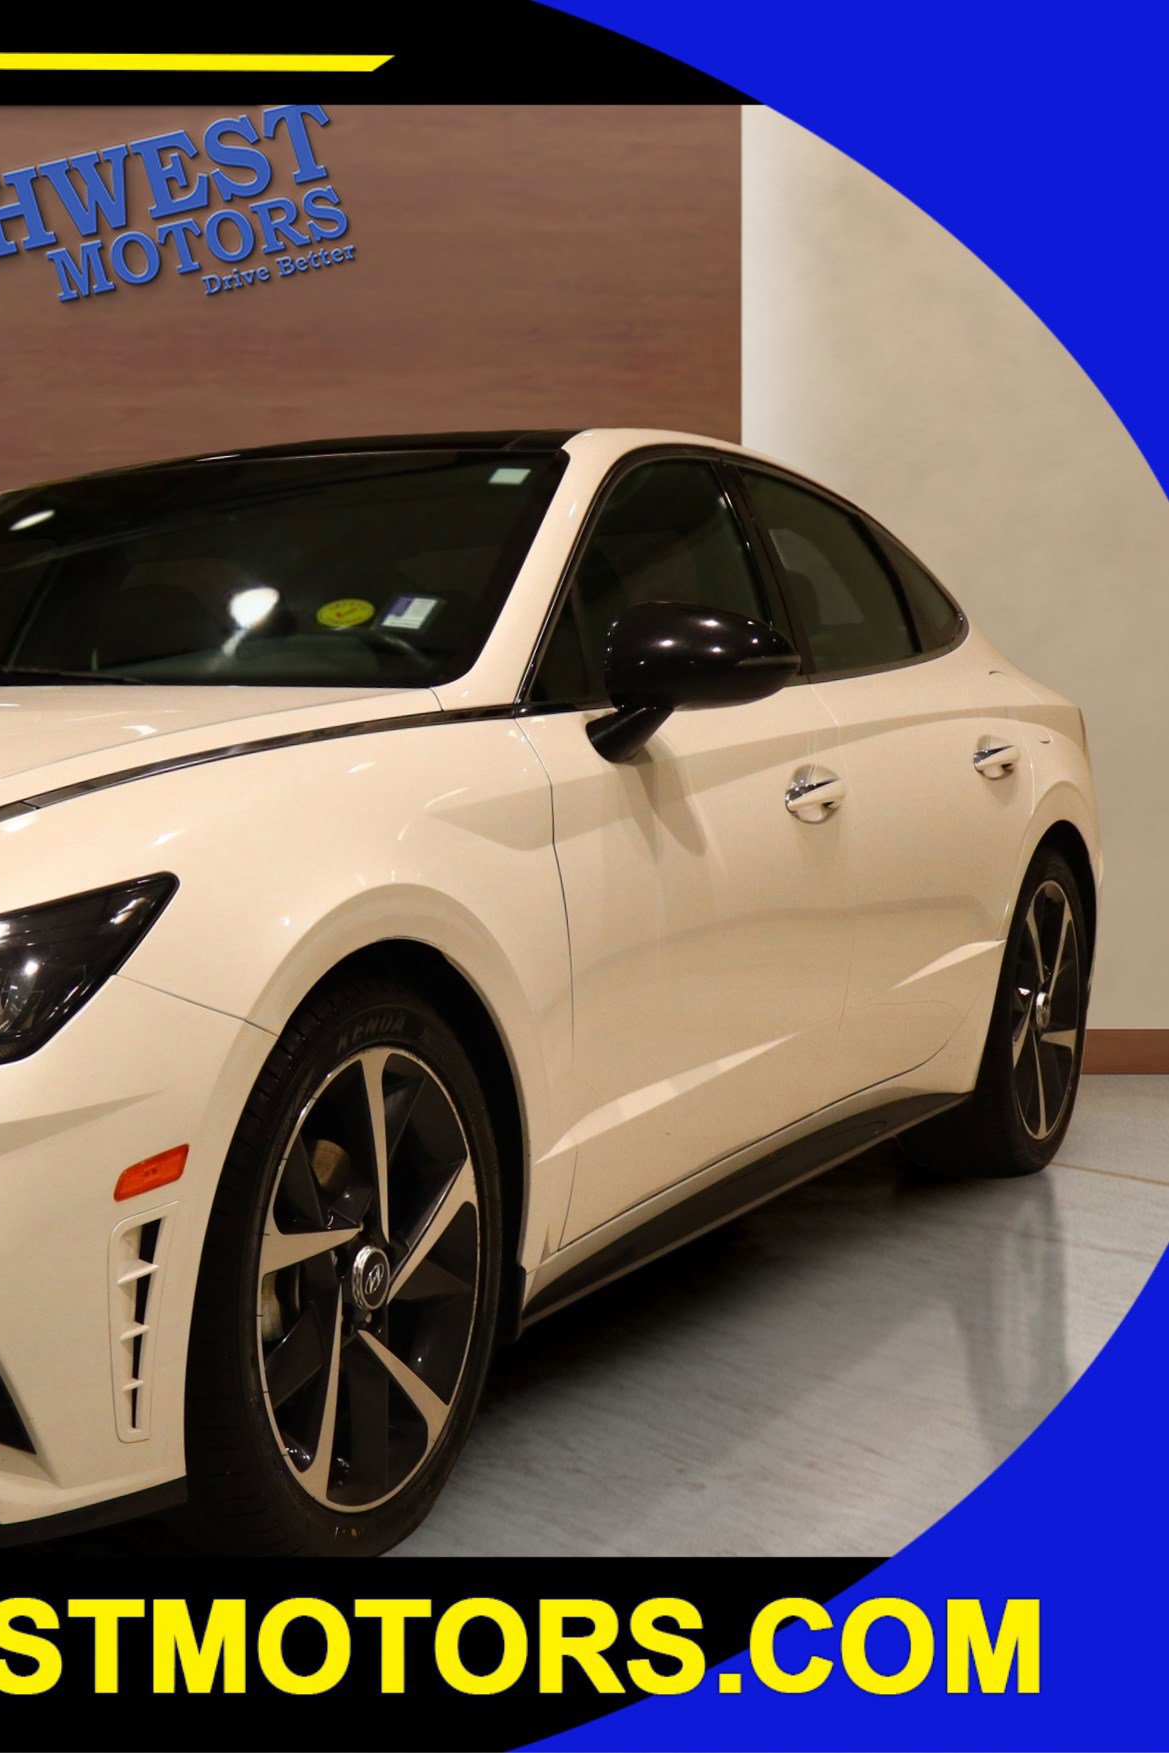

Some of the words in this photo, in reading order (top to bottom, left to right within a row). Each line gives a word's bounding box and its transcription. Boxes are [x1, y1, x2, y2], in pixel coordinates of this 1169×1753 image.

[47, 186, 348, 302] MOTORS
[202, 267, 270, 295] Drive
[276, 245, 354, 276] Better
